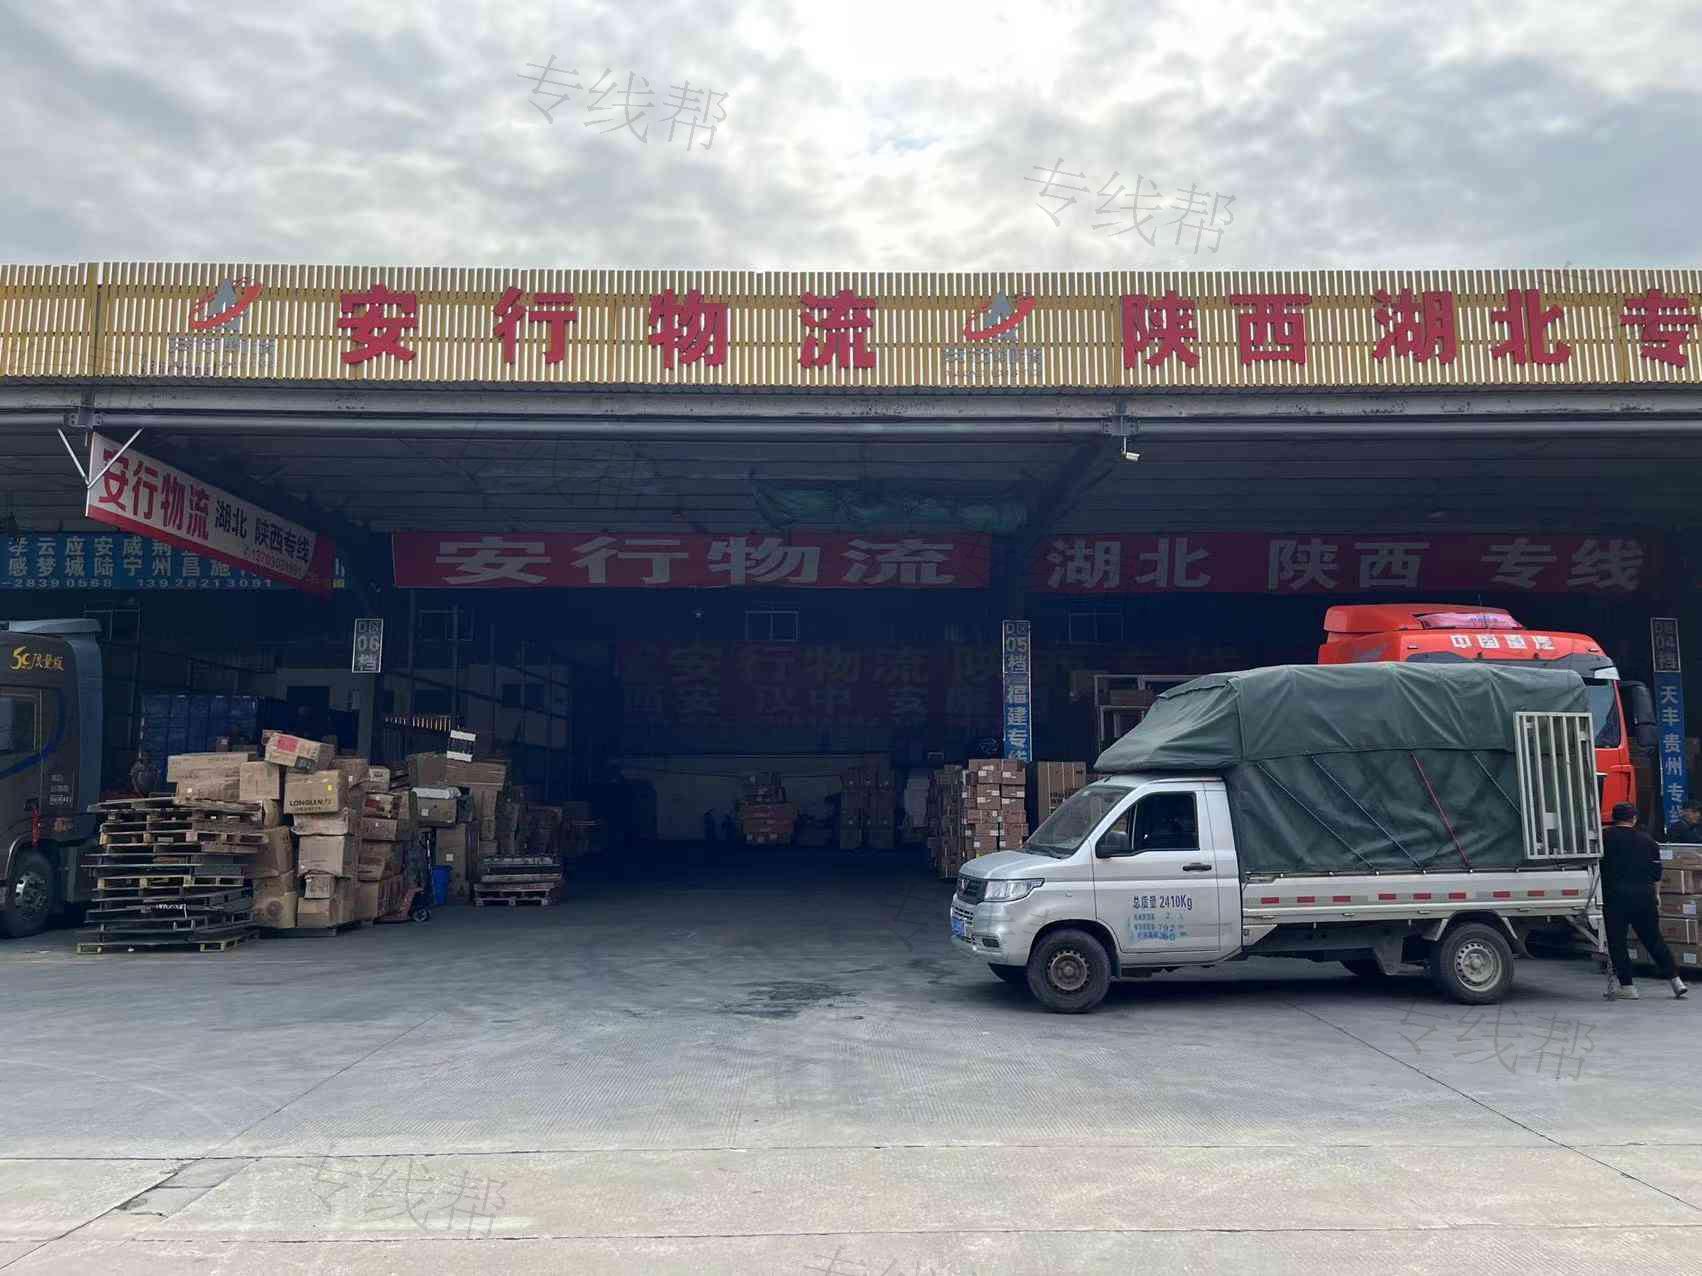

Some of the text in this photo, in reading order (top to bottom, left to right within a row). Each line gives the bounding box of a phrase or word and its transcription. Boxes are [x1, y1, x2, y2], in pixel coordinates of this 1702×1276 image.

[336, 283, 877, 369] 安行物流
[98, 447, 210, 541] 安行物流
[214, 499, 248, 538] 湖北
[435, 537, 955, 586] 安行物流
[1046, 537, 1648, 593] 湖北 陕西 专线
[1159, 894, 1193, 911] 2410Kg
